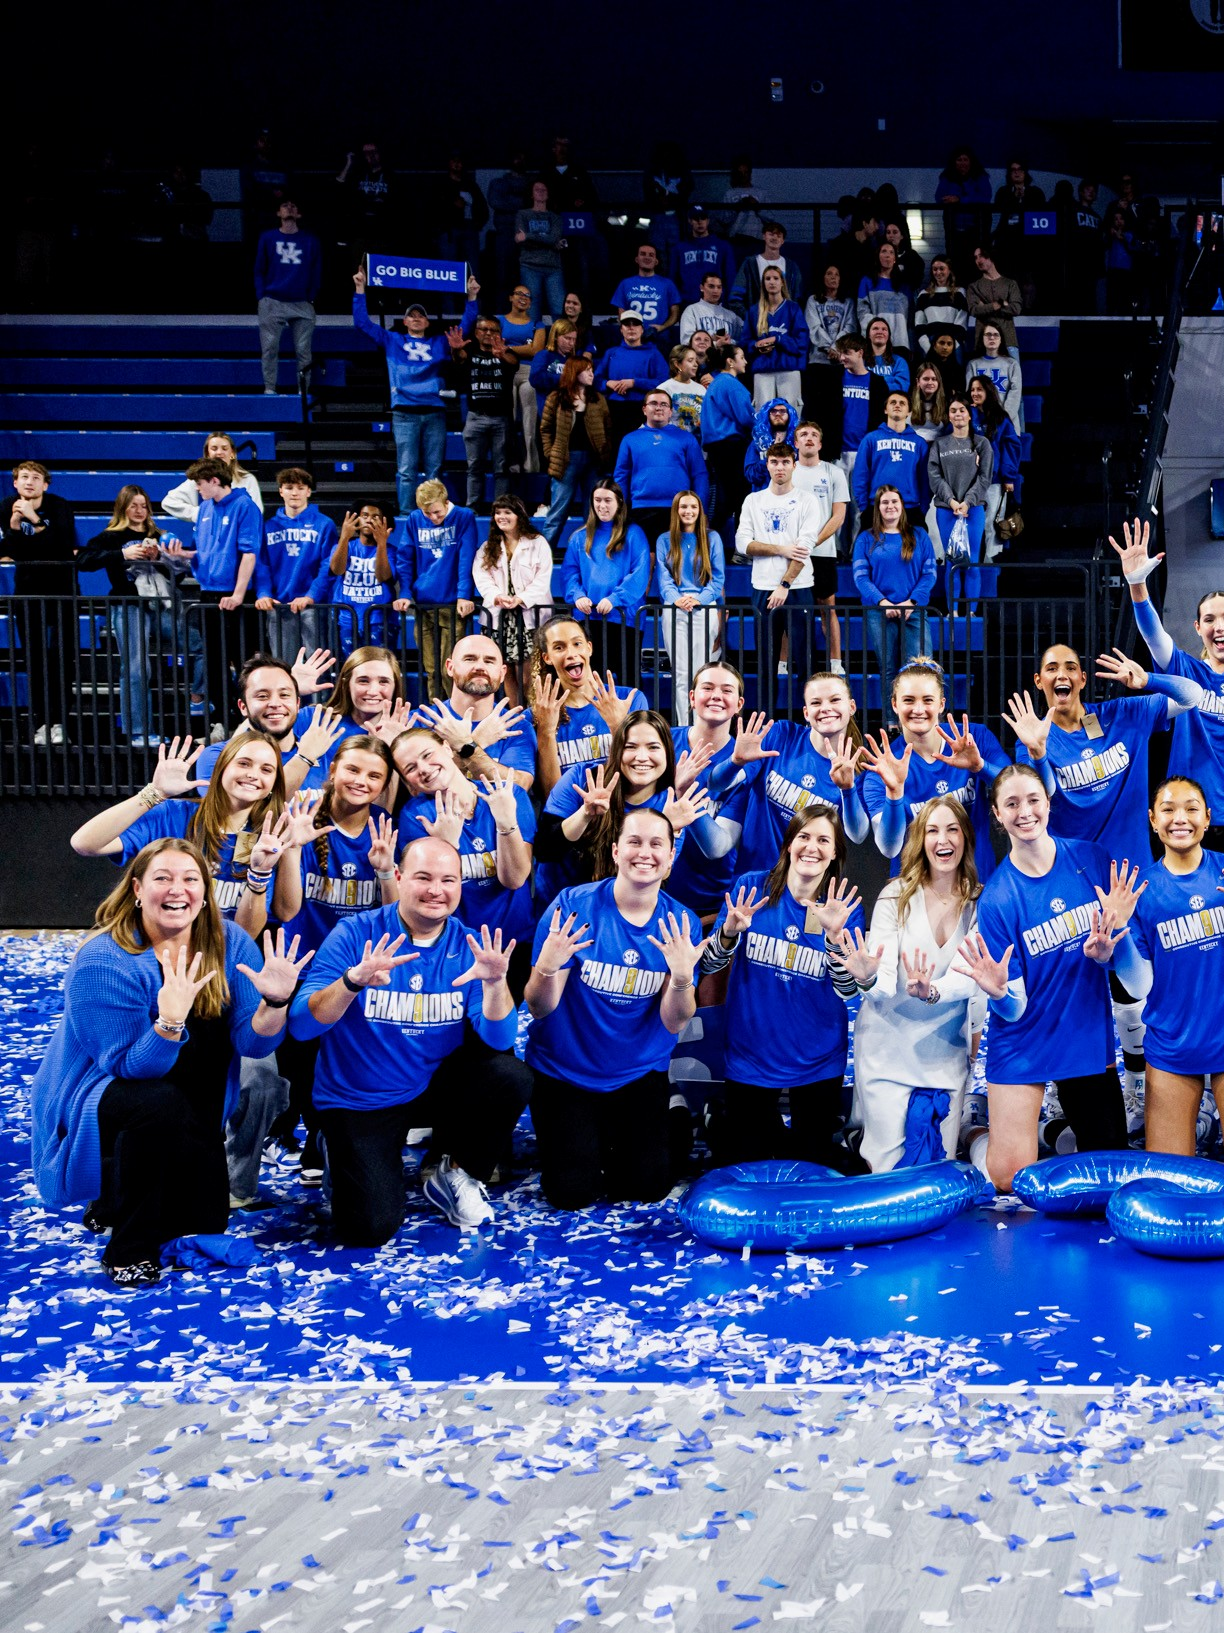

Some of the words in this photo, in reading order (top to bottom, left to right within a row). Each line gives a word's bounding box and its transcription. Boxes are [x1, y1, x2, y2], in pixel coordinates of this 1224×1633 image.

[568, 218, 585, 229] 10
[1032, 218, 1049, 228] 10
[276, 241, 302, 264] UK
[376, 265, 397, 276] GO
[400, 267, 422, 278] BIG
[425, 269, 458, 281] BLUE
[877, 439, 916, 453] KENTUCKY
[266, 528, 319, 545] KENTUCKY
[343, 571, 380, 586] BLU
[343, 585, 384, 597] NATION
[582, 724, 596, 735] SEC
[801, 774, 816, 789] SEC
[935, 780, 949, 794] SEC
[473, 837, 486, 851] SEC
[342, 863, 357, 878] SEC
[1049, 897, 1066, 913] SEC
[1188, 894, 1205, 910] SEC
[785, 924, 801, 941] SEC
[623, 949, 640, 966] SEC
[580, 959, 666, 995] CHAM9ION
[364, 988, 464, 1024] CHAM9IONS
